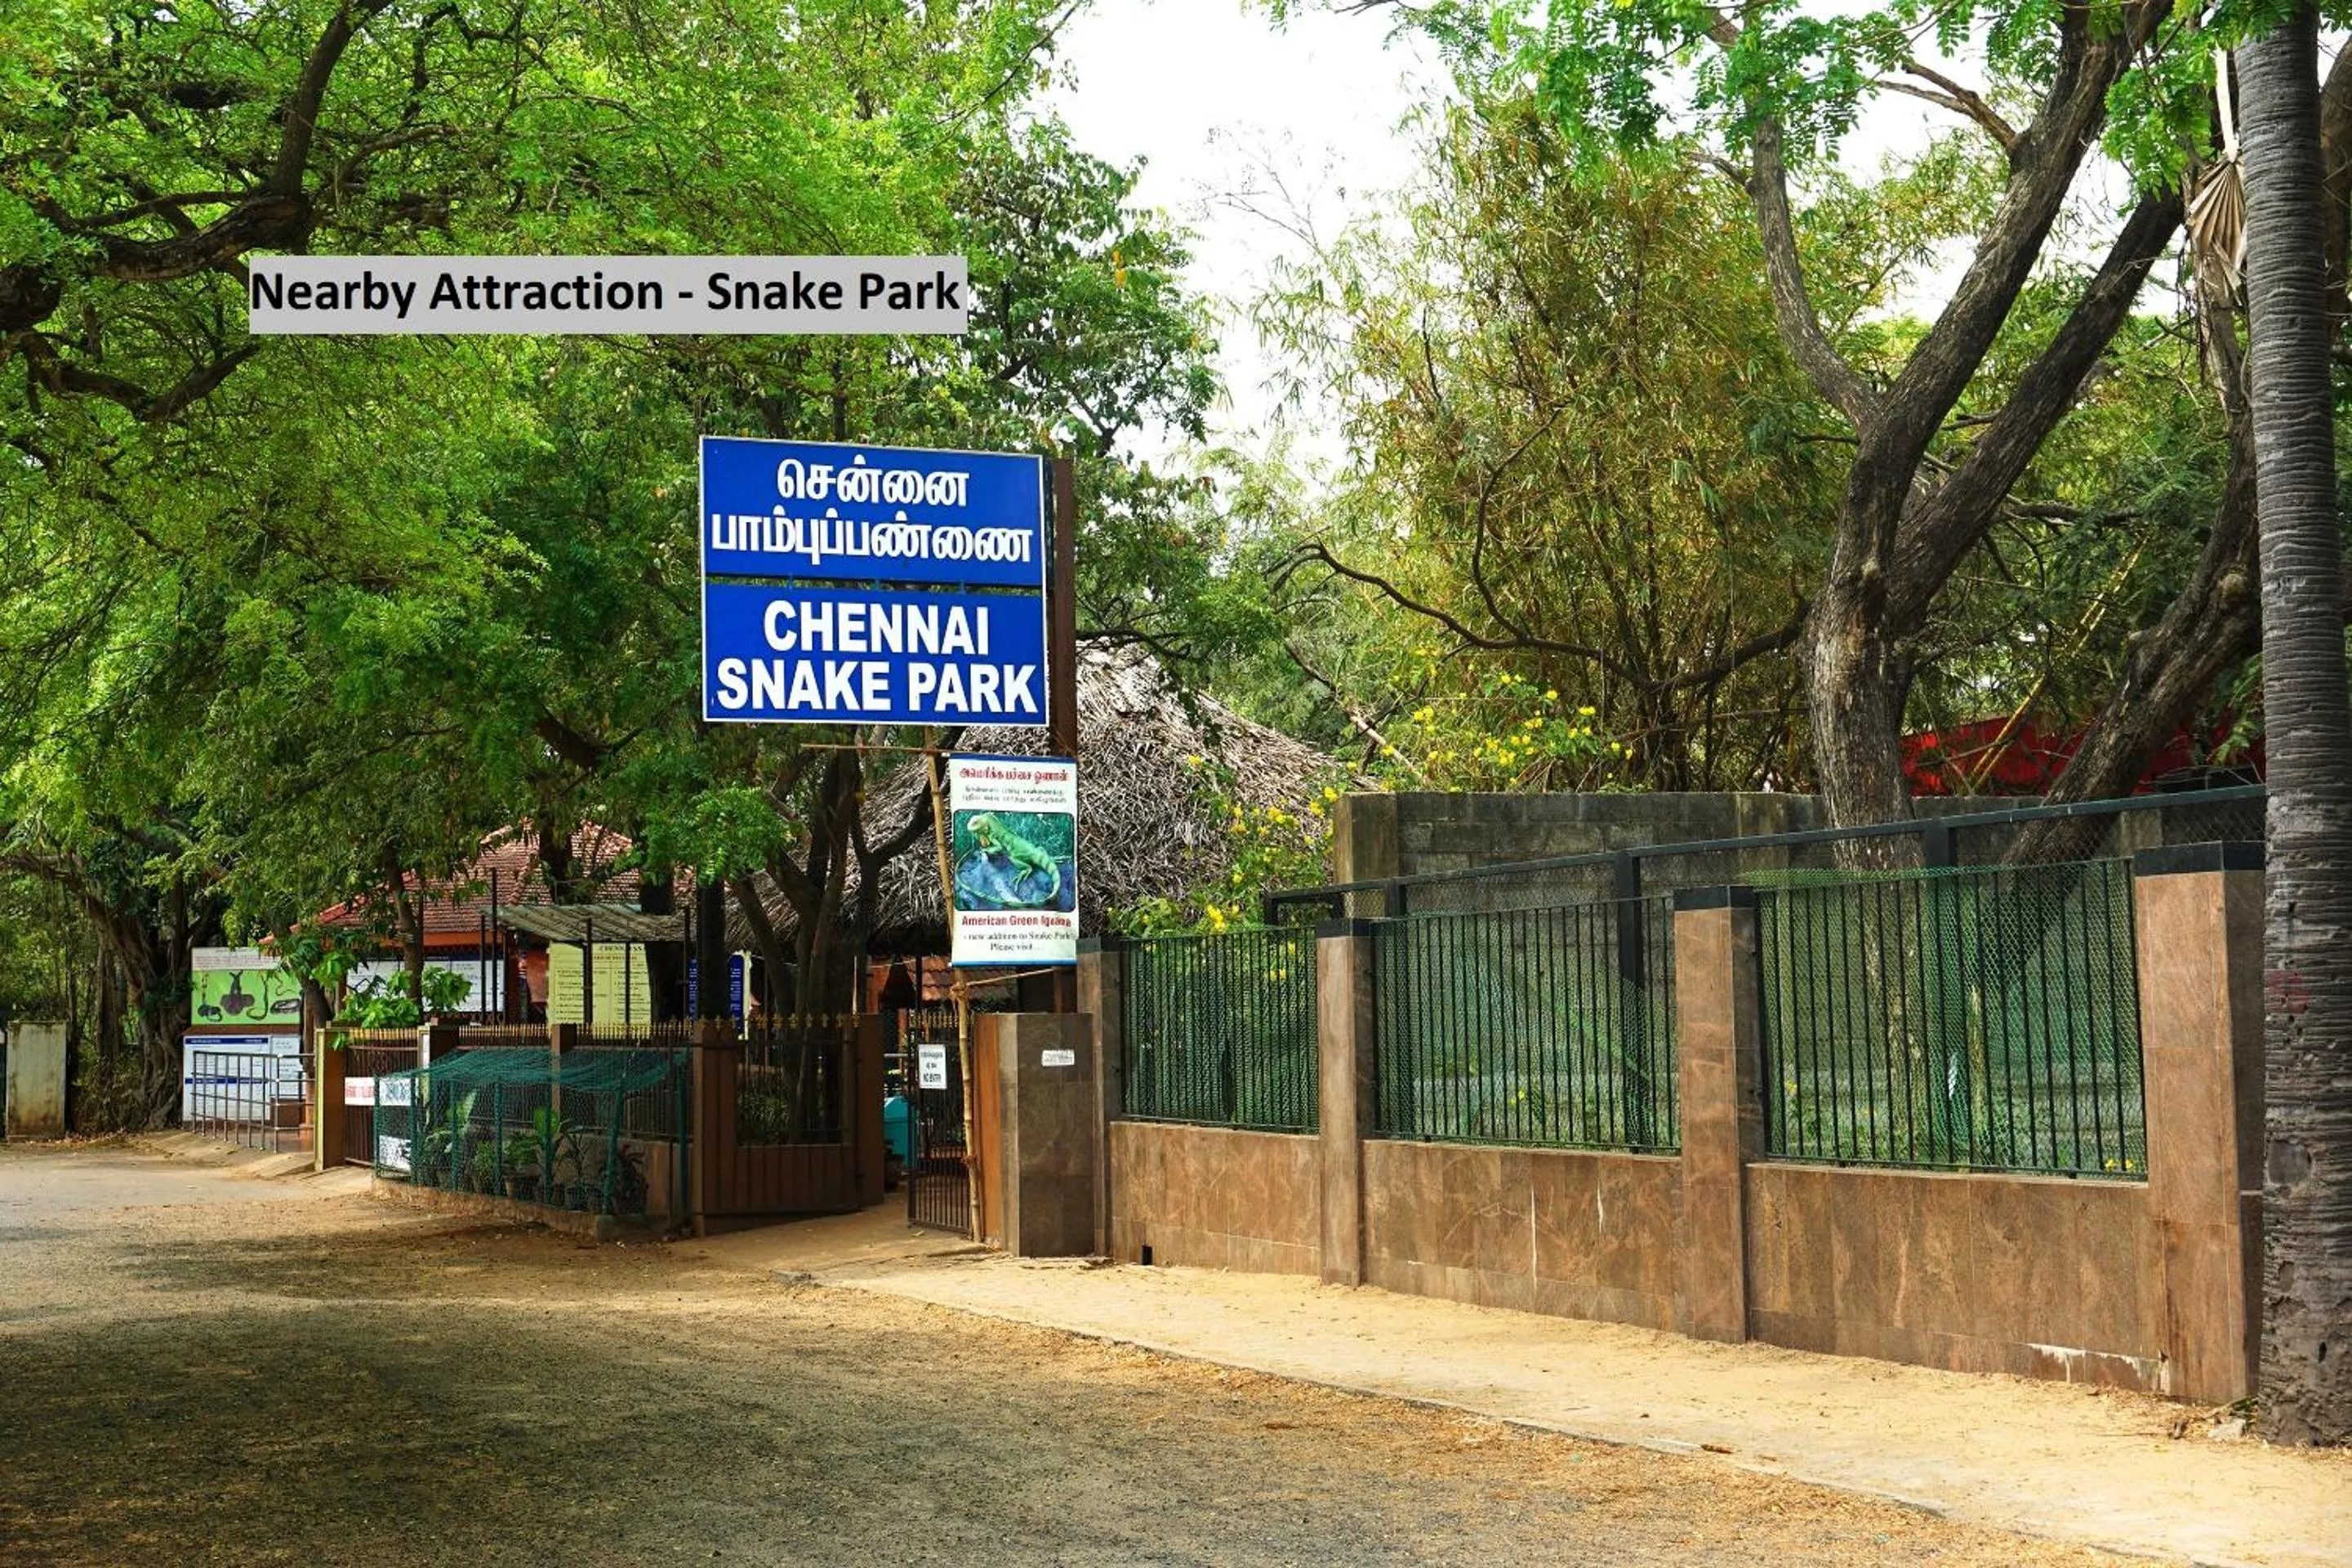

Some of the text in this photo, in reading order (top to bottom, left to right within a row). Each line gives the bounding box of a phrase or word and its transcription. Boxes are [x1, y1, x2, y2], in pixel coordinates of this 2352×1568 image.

[777, 454, 969, 506] சென்னை
[711, 505, 1033, 565] பாம்புப்பண்ணை
[764, 599, 989, 655] CHENNAI
[717, 657, 1038, 713] SNAKE PARK
[962, 915, 1007, 926] American
[1009, 915, 1039, 926] Green
[990, 942, 1013, 951] Please
